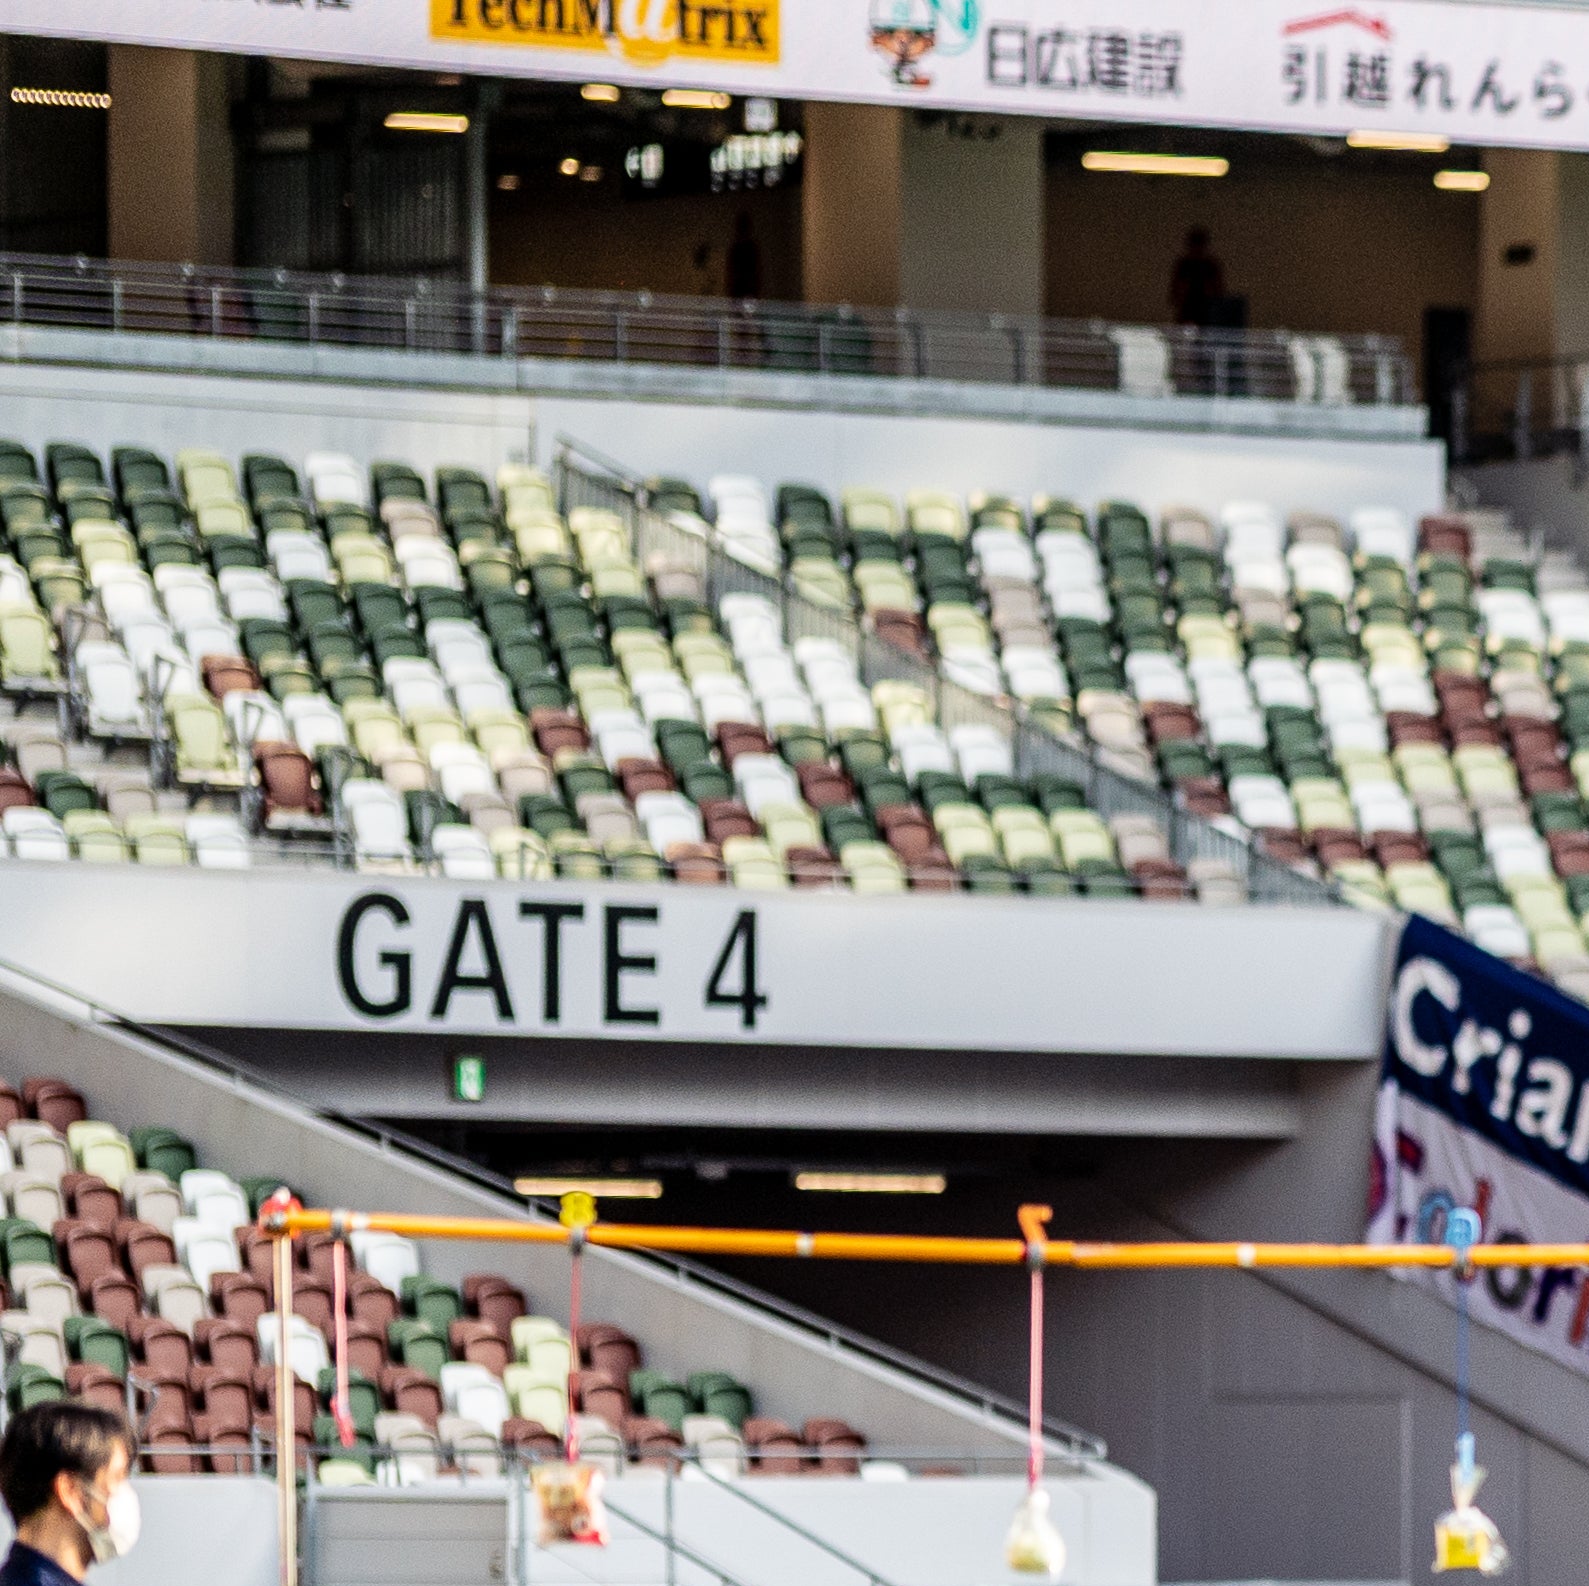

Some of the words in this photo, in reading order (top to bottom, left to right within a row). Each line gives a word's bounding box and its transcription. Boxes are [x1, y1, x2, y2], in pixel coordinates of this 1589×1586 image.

[984, 21, 1186, 96] 日広建設
[336, 892, 660, 1026] GATE
[704, 906, 769, 1029] 4
